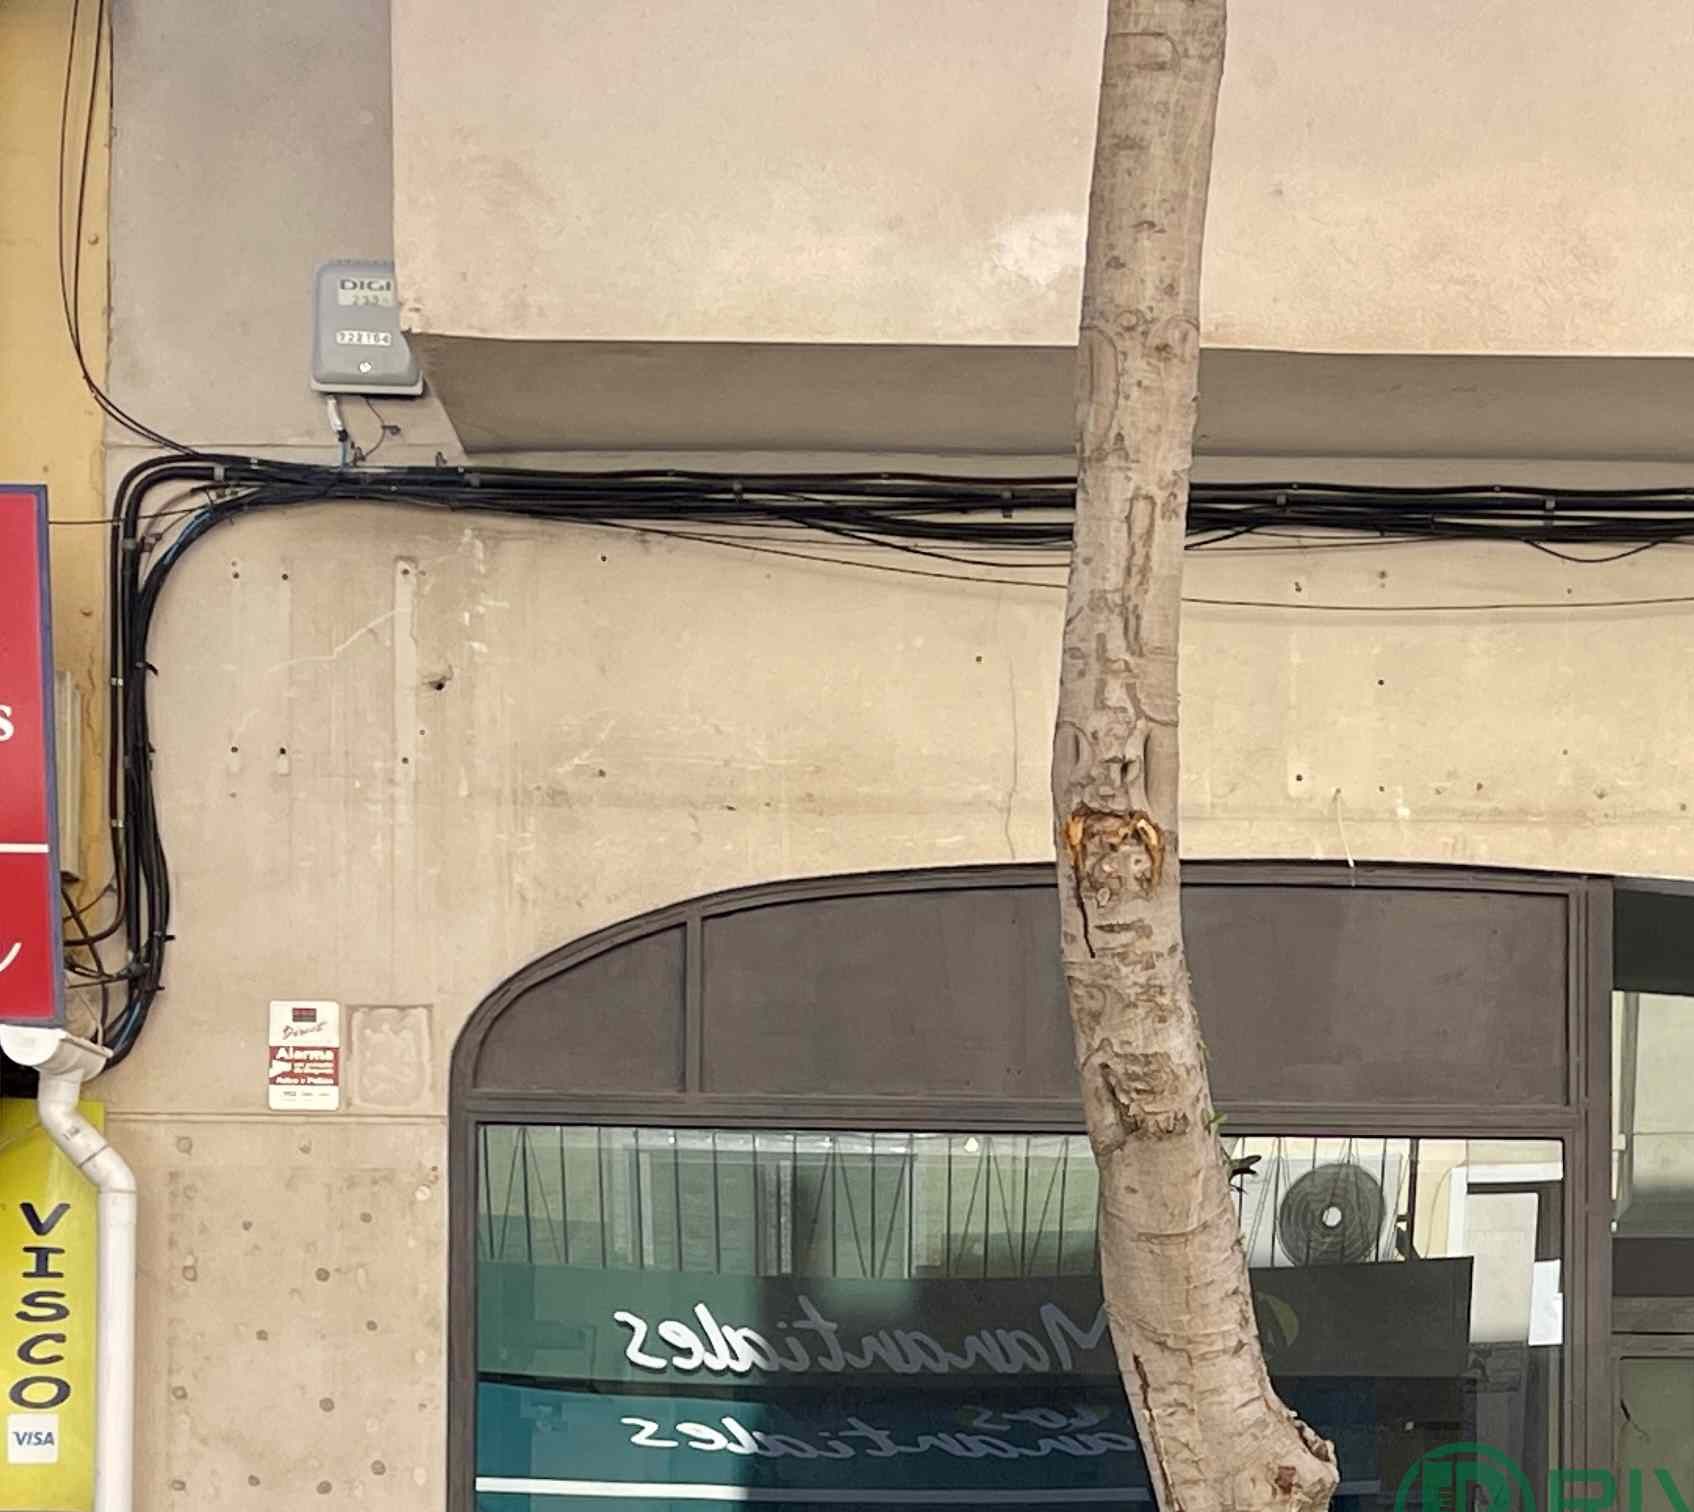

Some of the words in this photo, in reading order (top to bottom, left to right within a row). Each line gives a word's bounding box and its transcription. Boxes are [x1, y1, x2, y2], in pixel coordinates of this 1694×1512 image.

[340, 279, 391, 291] DIGI
[275, 1046, 335, 1060] Alarma
[9, 1201, 72, 1410] VISCO
[13, 1430, 55, 1446] VISA
